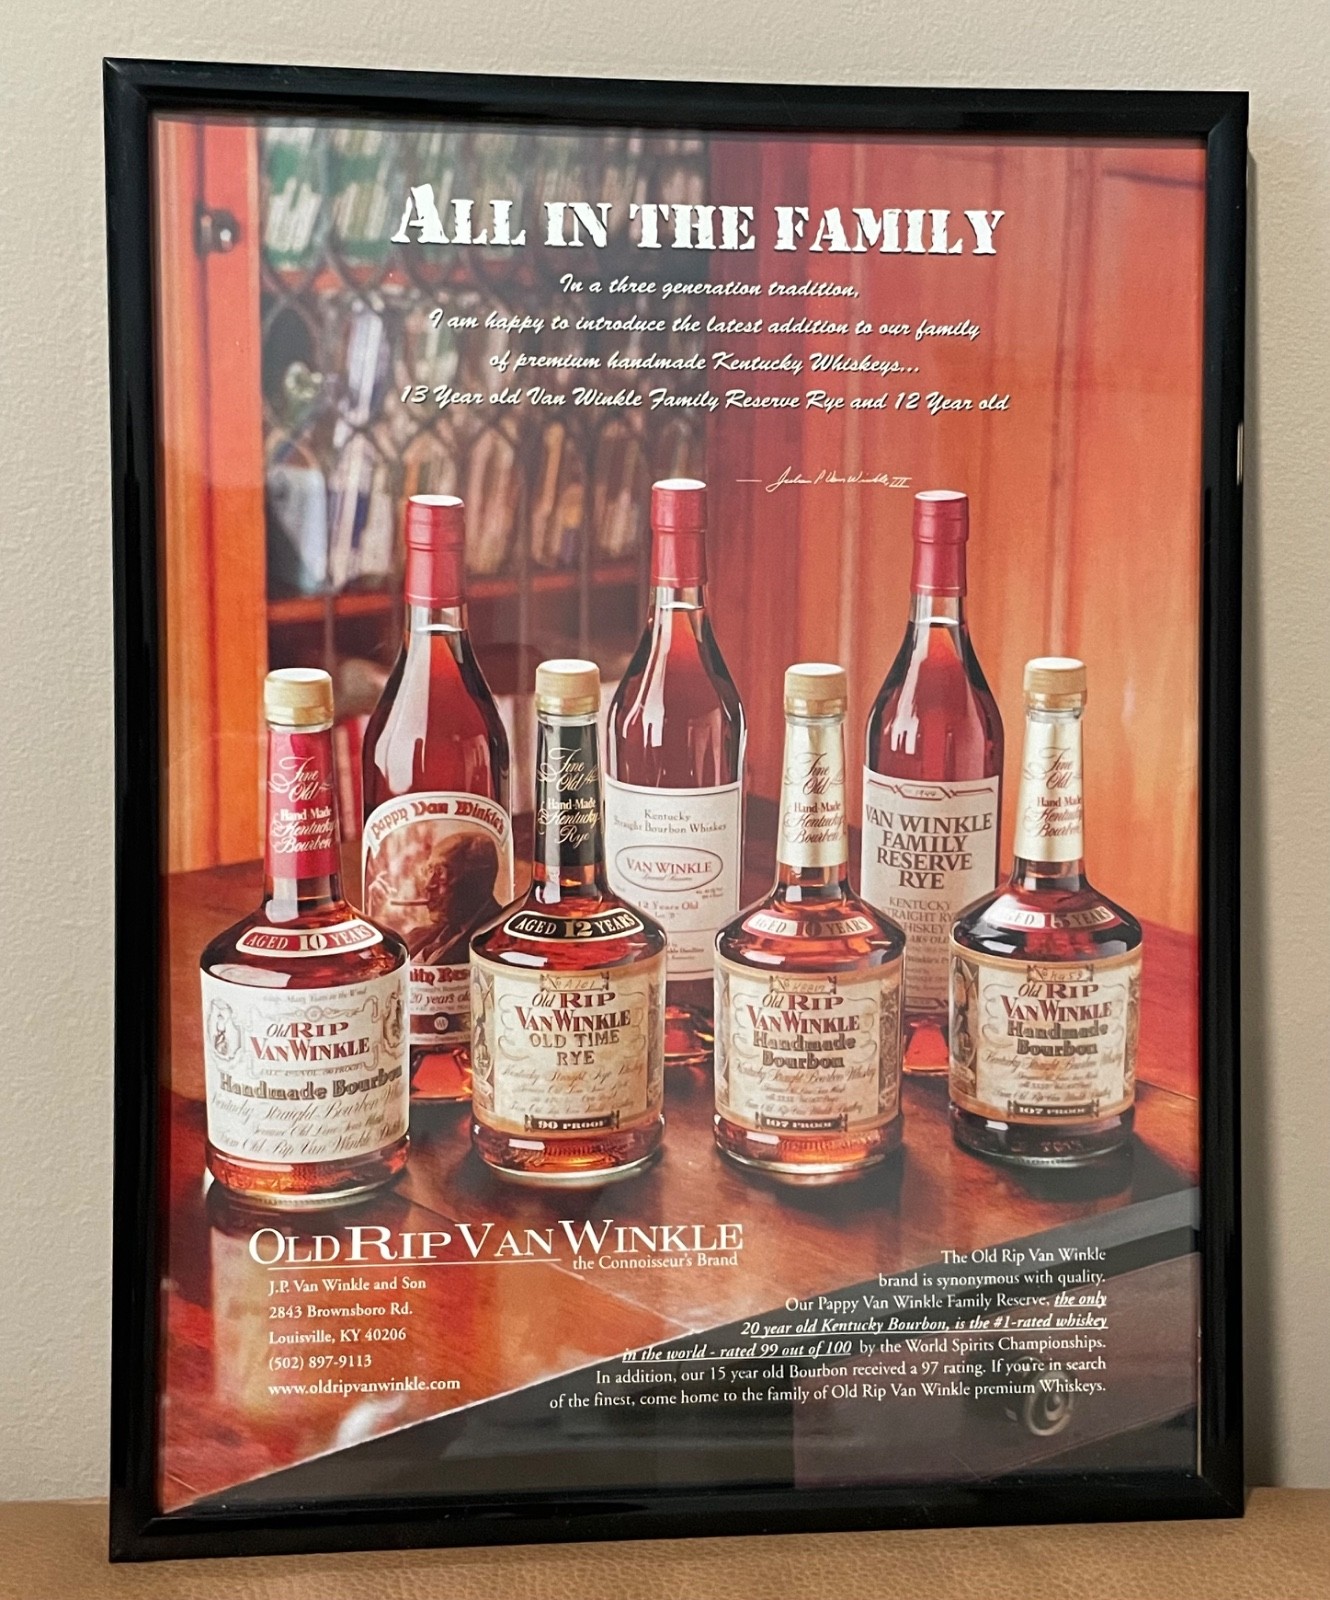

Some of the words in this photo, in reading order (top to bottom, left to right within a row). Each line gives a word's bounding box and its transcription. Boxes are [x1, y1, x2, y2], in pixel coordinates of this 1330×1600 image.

[391, 183, 526, 246] ALL
[544, 202, 613, 248] IN
[630, 204, 755, 251] THE
[773, 206, 1005, 256] FAMILY
[559, 273, 584, 293] In
[588, 282, 603, 294] a
[608, 275, 658, 294] three
[661, 280, 763, 300] generation
[767, 280, 860, 301] tradition,
[428, 308, 444, 329] I
[447, 317, 479, 329] am
[485, 315, 545, 334] happy
[551, 317, 570, 330] to
[575, 315, 666, 332] introduce
[671, 314, 702, 333] the
[706, 315, 763, 334] latest
[768, 317, 848, 334] addition
[855, 321, 873, 335] to
[879, 325, 910, 335] our
[916, 319, 980, 341] family
[489, 351, 508, 370] of
[513, 353, 602, 371] premium
[607, 351, 706, 370] handmade
[712, 352, 803, 375] Kentucky
[809, 353, 920, 375] Whiskeys...
[401, 386, 430, 404] 13
[433, 387, 484, 409] Year
[489, 391, 521, 405] old
[526, 388, 566, 406] Van
[572, 387, 643, 407] Winkle
[648, 388, 719, 411] Family
[725, 390, 801, 409] Reserve
[806, 390, 845, 411] Rye
[850, 394, 886, 410] and
[894, 393, 921, 409] 12
[926, 393, 974, 413] Year
[978, 394, 1010, 411] old
[371, 807, 408, 840] Pappy
[411, 801, 449, 816] Van
[644, 809, 691, 823] Kentucky
[866, 804, 893, 829] VAN
[899, 812, 992, 835] WINKLE
[645, 823, 687, 834] Bourbon
[882, 829, 969, 854] FAMILY
[626, 858, 652, 873] VAN
[656, 861, 713, 875] WINKLE
[877, 846, 973, 872] RESERVE
[899, 869, 946, 891] RYE
[889, 896, 951, 911] KENTUCKY
[515, 918, 557, 935] AGED
[564, 920, 594, 938] 12
[594, 913, 636, 934] YEARS
[246, 934, 289, 950] AGED
[299, 933, 328, 952] 10
[331, 925, 373, 946] YEARS
[531, 992, 556, 1008] Old
[559, 992, 616, 1009] RIP
[1018, 984, 1042, 998] Old
[1046, 984, 1099, 998] RIP
[762, 994, 785, 1009] Old
[788, 995, 844, 1011] RIP
[266, 1023, 291, 1039] Old
[289, 1021, 349, 1038] RIP
[529, 1033, 566, 1049] OLD
[574, 1030, 620, 1047] TIME
[556, 1050, 595, 1067] RYE
[538, 1120, 558, 1130] 90
[248, 1228, 342, 1265] OLD
[344, 1226, 452, 1260] RIP
[455, 1223, 554, 1258] VAN
[558, 1220, 744, 1252] WINKLE
[573, 1256, 595, 1270] the
[598, 1254, 692, 1270] Connoisseur's
[697, 1251, 738, 1267] Brand
[940, 1250, 968, 1264] The
[971, 1248, 997, 1263] Old
[1001, 1249, 1026, 1267] Rip
[1028, 1248, 1054, 1262] Van
[1058, 1247, 1106, 1261] Winkle
[267, 1279, 290, 1297] J.P.
[292, 1279, 319, 1293] Van
[321, 1277, 370, 1292] Winkle
[373, 1275, 398, 1291] and
[401, 1275, 427, 1290] Son
[879, 1272, 918, 1288] brand
[923, 1273, 933, 1287] is
[937, 1274, 1020, 1290] synonymous
[1023, 1270, 1053, 1284] with
[1058, 1271, 1106, 1288] quality.
[269, 1304, 303, 1319] 2843
[307, 1302, 387, 1318] Brownsboro
[389, 1301, 413, 1316] Rd.
[785, 1297, 815, 1311] Our
[818, 1297, 859, 1316] Pappy
[863, 1295, 889, 1309] Van
[892, 1293, 943, 1309] Winkle
[947, 1293, 993, 1311] Family
[996, 1292, 1049, 1308] Reserve,
[1054, 1292, 1076, 1305] the
[1079, 1291, 1107, 1307] only
[268, 1329, 336, 1345] Louisville,
[339, 1327, 362, 1343] KY
[364, 1326, 407, 1342] 40206
[741, 1321, 759, 1335] 20
[764, 1323, 791, 1339] year
[796, 1319, 816, 1334] old
[820, 1319, 883, 1334] Kentucky
[888, 1317, 949, 1332] Bourbon,
[955, 1316, 965, 1329] is
[970, 1315, 989, 1329] the
[994, 1313, 1052, 1328] #1-rated
[1056, 1312, 1107, 1330] whiskey
[622, 1347, 643, 1361] in
[643, 1346, 663, 1360] the
[668, 1344, 707, 1359] world
[720, 1343, 755, 1358] rated
[761, 1344, 777, 1358] 99
[782, 1345, 804, 1357] out
[809, 1343, 821, 1359] of
[826, 1341, 851, 1356] 100
[859, 1341, 875, 1358] by
[880, 1340, 901, 1353] the
[906, 1339, 947, 1353] World
[951, 1338, 995, 1357] Spirits
[998, 1336, 1106, 1353] Championships.
[269, 1355, 304, 1372] (502)
[308, 1353, 372, 1370] 897-9113
[596, 1371, 611, 1384] In
[615, 1368, 677, 1385] addition,
[681, 1372, 705, 1382] our
[710, 1366, 727, 1381] 15
[730, 1369, 760, 1384] year
[762, 1364, 785, 1380] old
[789, 1364, 848, 1379] Bourbon
[852, 1360, 907, 1376] received
[910, 1365, 918, 1375] a
[921, 1361, 940, 1376] 97
[943, 1360, 986, 1378] rating.
[992, 1358, 1002, 1372] If
[1006, 1357, 1045, 1376] you're
[1048, 1357, 1061, 1371] in
[1066, 1357, 1106, 1371] search
[267, 1375, 461, 1398] www.oldripvanwinkle.com
[550, 1393, 567, 1409] of
[569, 1393, 590, 1408] the
[594, 1391, 636, 1407] finest,
[639, 1395, 677, 1405] come
[681, 1390, 720, 1404] home
[723, 1391, 738, 1402] to
[742, 1387, 764, 1402] the
[767, 1386, 810, 1405] family
[814, 1384, 830, 1400] of
[831, 1384, 858, 1398] Old
[862, 1384, 887, 1402] Rip
[890, 1383, 917, 1397] Van
[921, 1382, 970, 1396] Winkle
[974, 1380, 1034, 1399] premium
[1040, 1378, 1106, 1394] Whiskeys.
